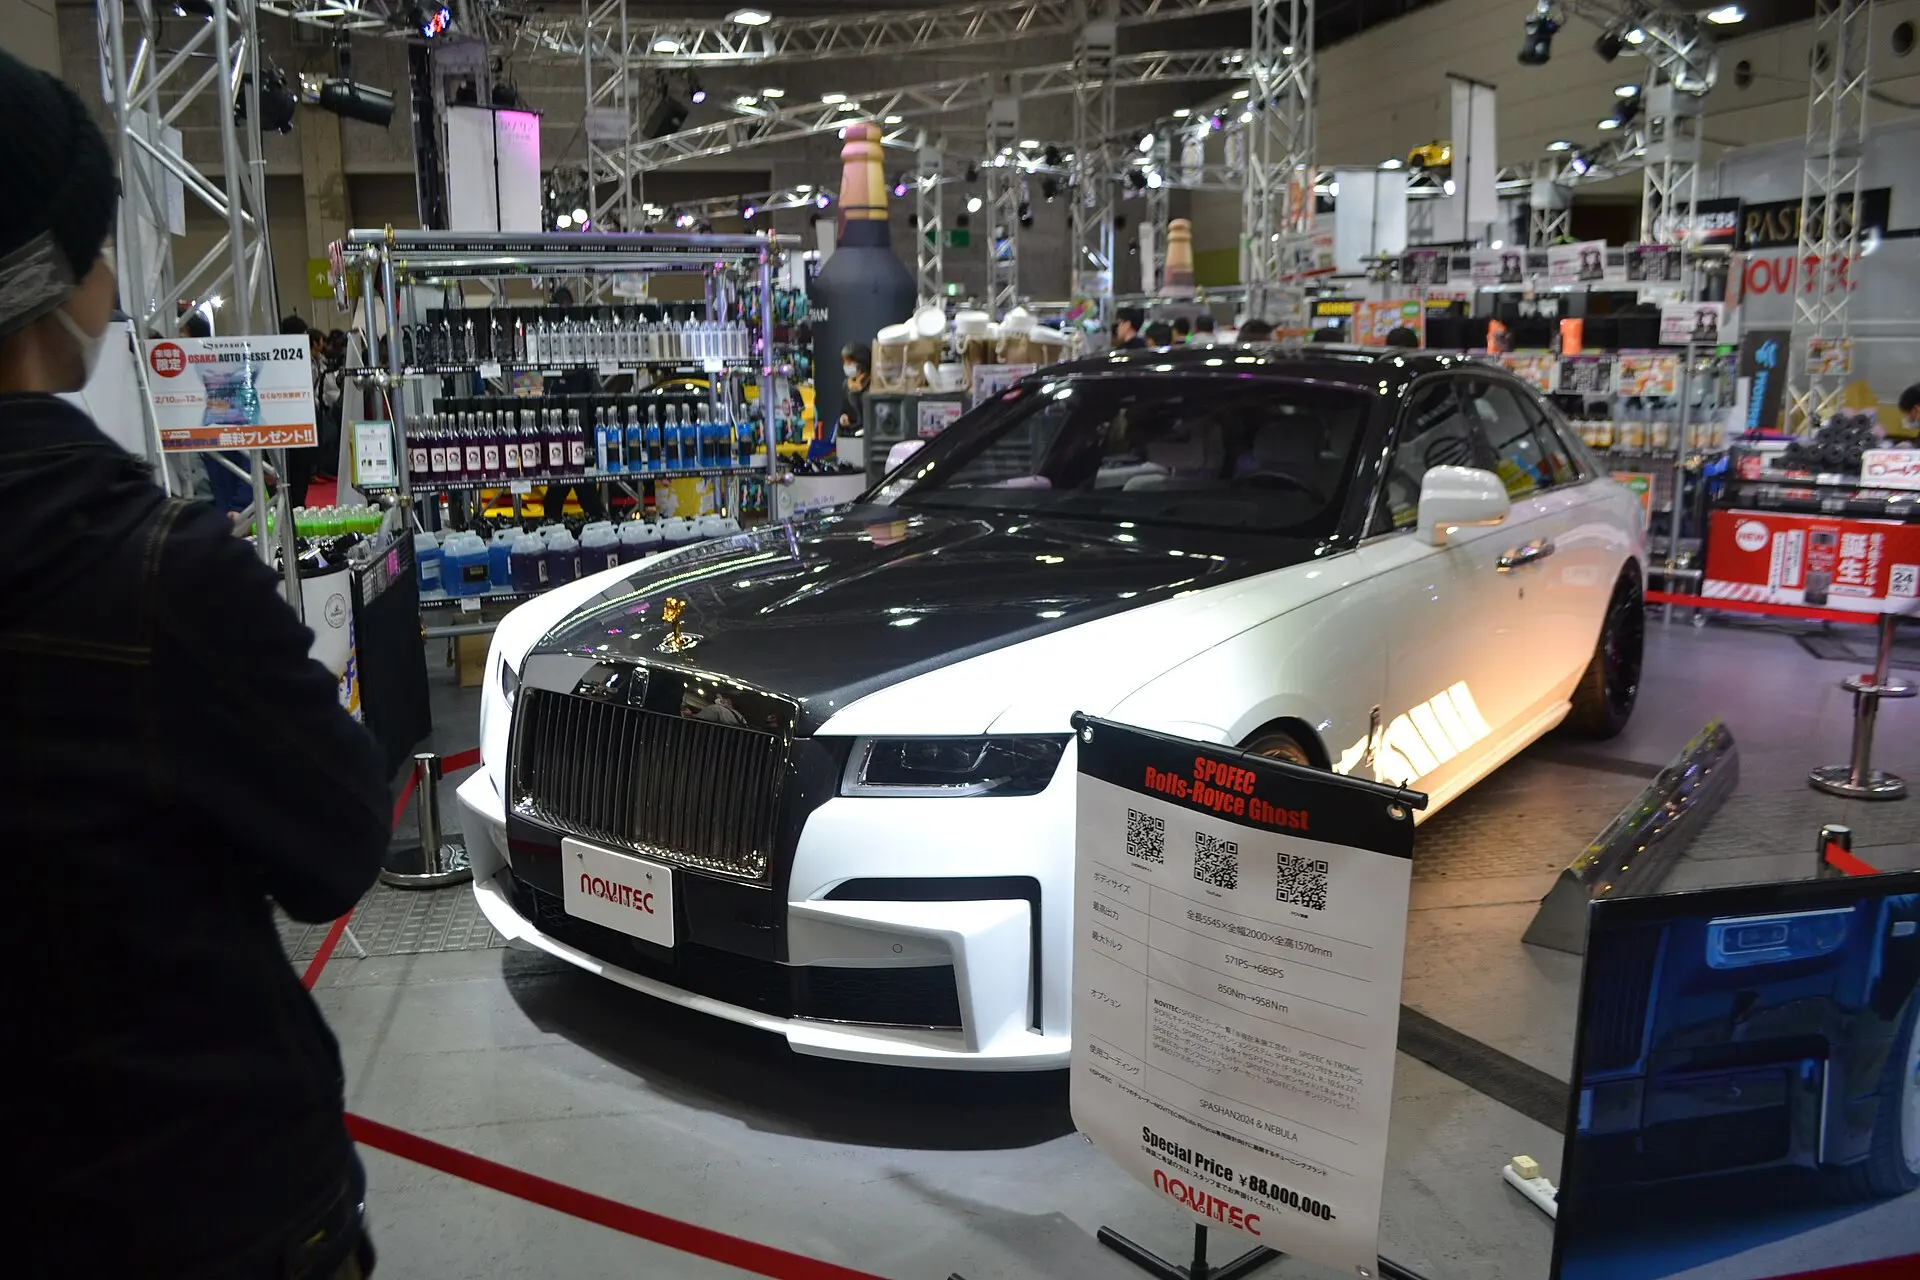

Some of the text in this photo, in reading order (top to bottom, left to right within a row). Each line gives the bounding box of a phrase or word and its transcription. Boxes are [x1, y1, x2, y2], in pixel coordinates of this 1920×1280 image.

[156, 359, 182, 372] 限定
[188, 353, 217, 364] OSAKA
[218, 352, 241, 362] AUTO
[272, 348, 304, 361] 2024
[219, 430, 313, 446] 無料プレゼント!!
[413, 485, 436, 493] PASHAN
[1737, 532, 1764, 543] NEW
[1836, 533, 1869, 585] 誕生
[1893, 571, 1914, 584] 24
[492, 594, 517, 602] SPASHAN
[1193, 756, 1256, 795] SPOFEC
[1145, 766, 1309, 830] Rolls-Royce Ghost
[580, 873, 654, 914] NOVITEC
[1093, 872, 1131, 895] ボディサイズ
[1092, 901, 1120, 921] 最高出力
[1091, 930, 1123, 951] 最大トルク
[1090, 988, 1121, 1008] オプション
[1089, 1044, 1140, 1075] 使用コーティング
[1199, 1098, 1298, 1142] SPASHAN2024 & NEBULA
[1142, 1125, 1192, 1165] Special
[1195, 1153, 1234, 1183] Price
[1154, 1167, 1261, 1236] NOVITEC
